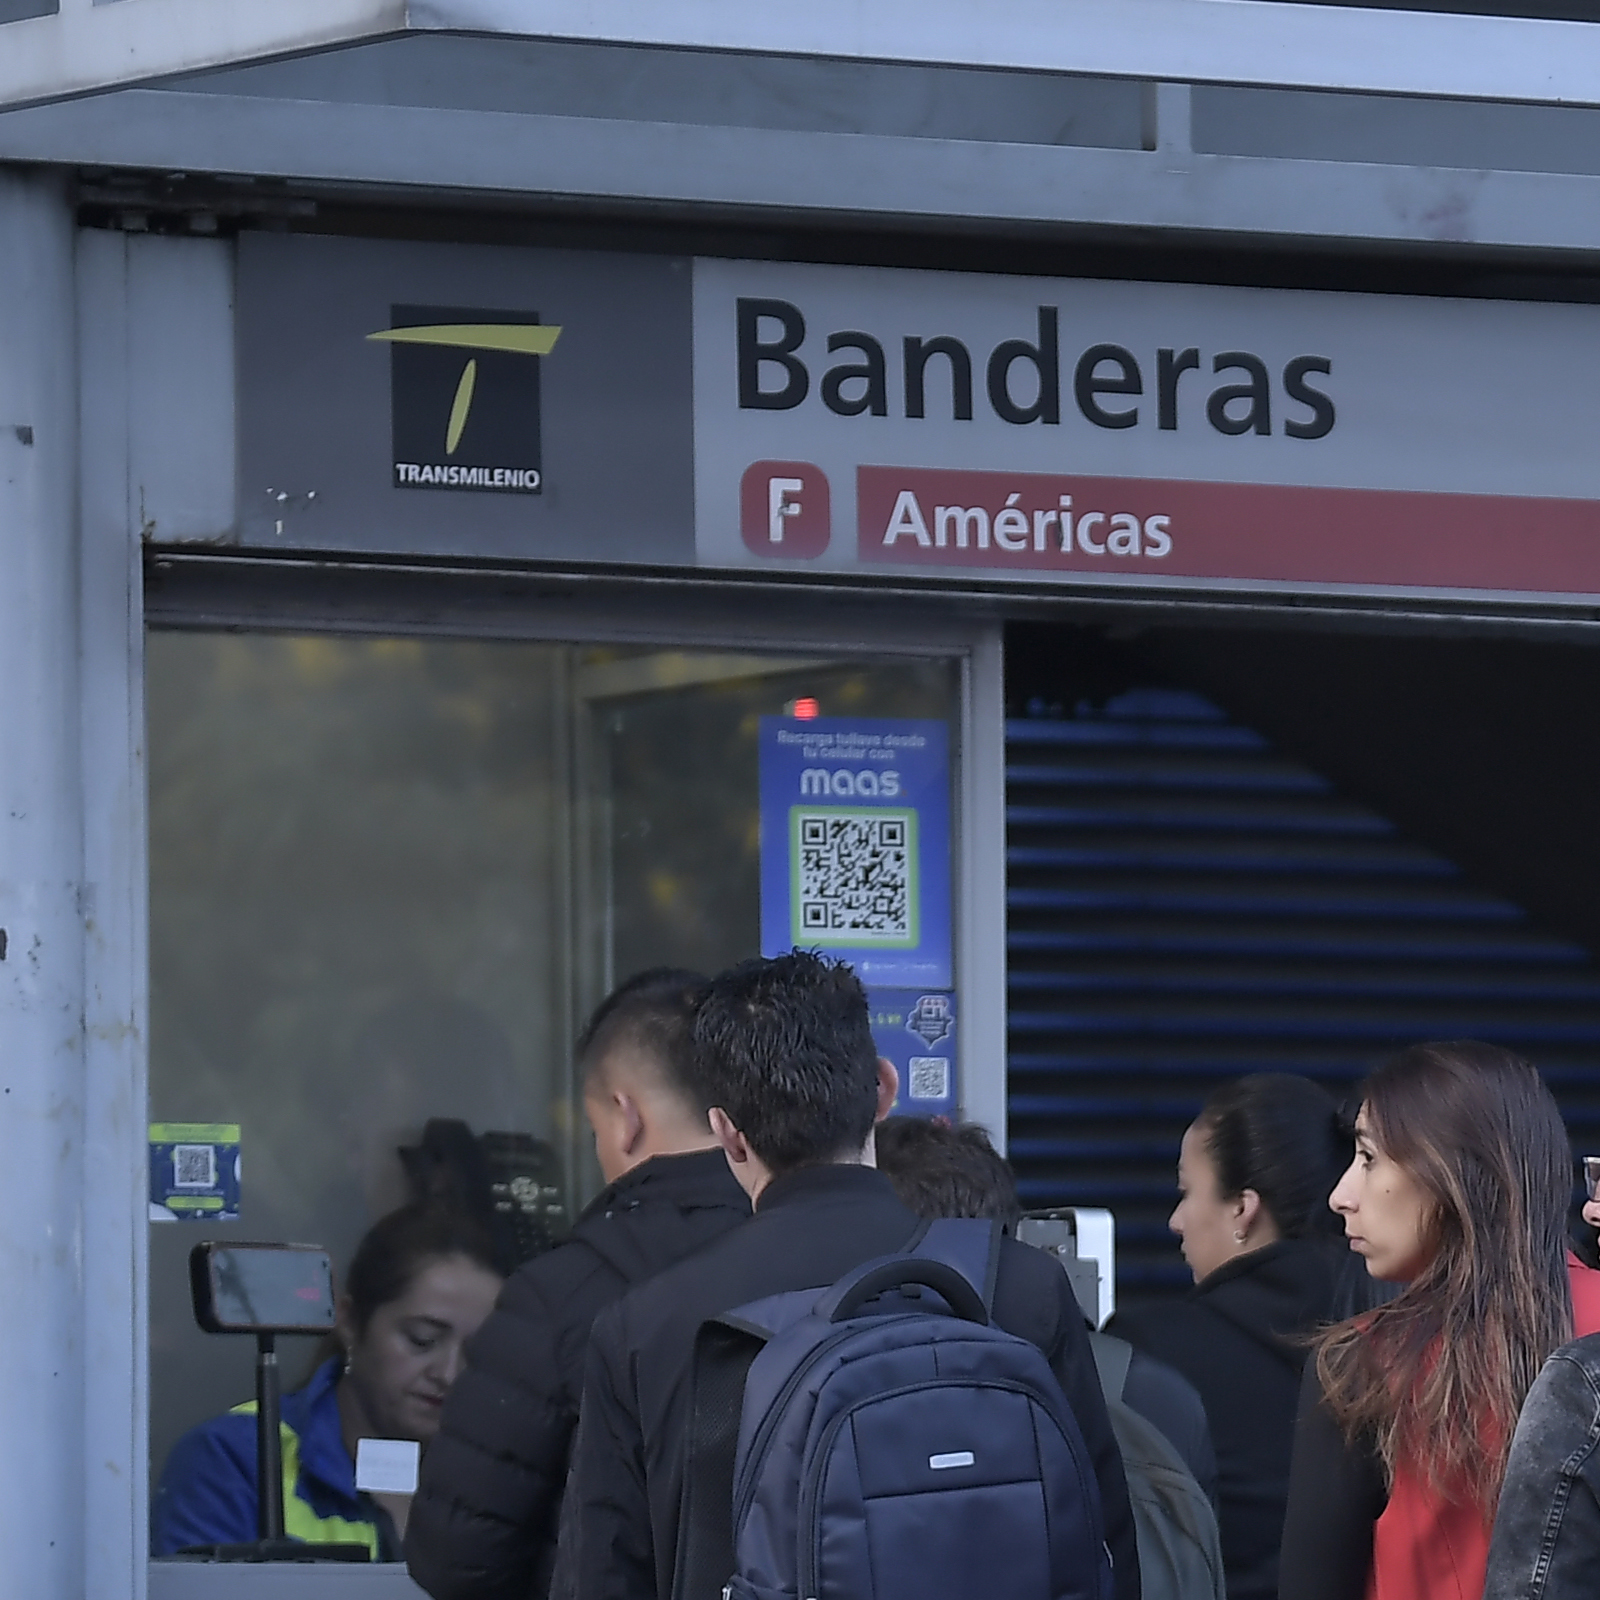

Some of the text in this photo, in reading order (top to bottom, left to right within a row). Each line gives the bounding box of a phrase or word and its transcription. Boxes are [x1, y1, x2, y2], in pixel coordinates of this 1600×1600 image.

[736, 296, 1336, 440] Banderas
[395, 463, 541, 490] TRANSMILENIO
[768, 477, 802, 543] F
[882, 489, 1173, 559] Américas
[777, 730, 833, 747] Recarga
[882, 734, 926, 746] desde
[803, 745, 895, 759] tu celular con
[801, 768, 901, 796] maas
